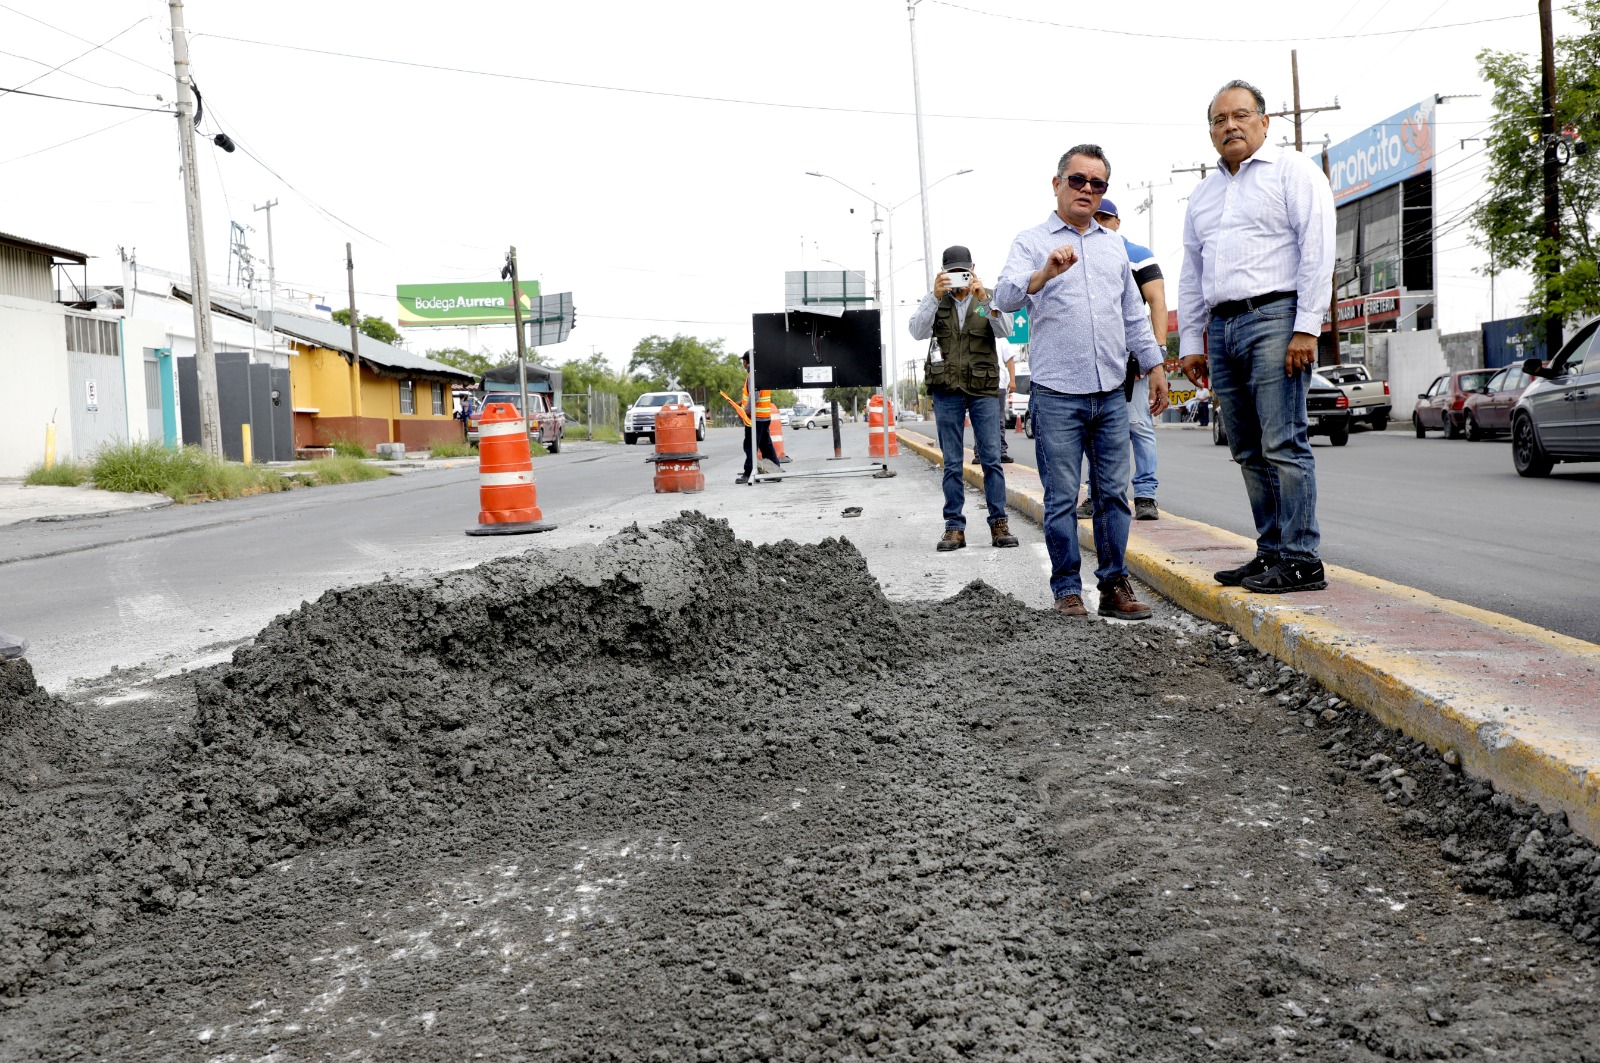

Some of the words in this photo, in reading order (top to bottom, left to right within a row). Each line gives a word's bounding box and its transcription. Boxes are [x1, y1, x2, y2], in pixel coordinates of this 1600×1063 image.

[415, 296, 455, 311] Bodega
[456, 296, 505, 307] Aurrera
[1357, 303, 1362, 318] Y
